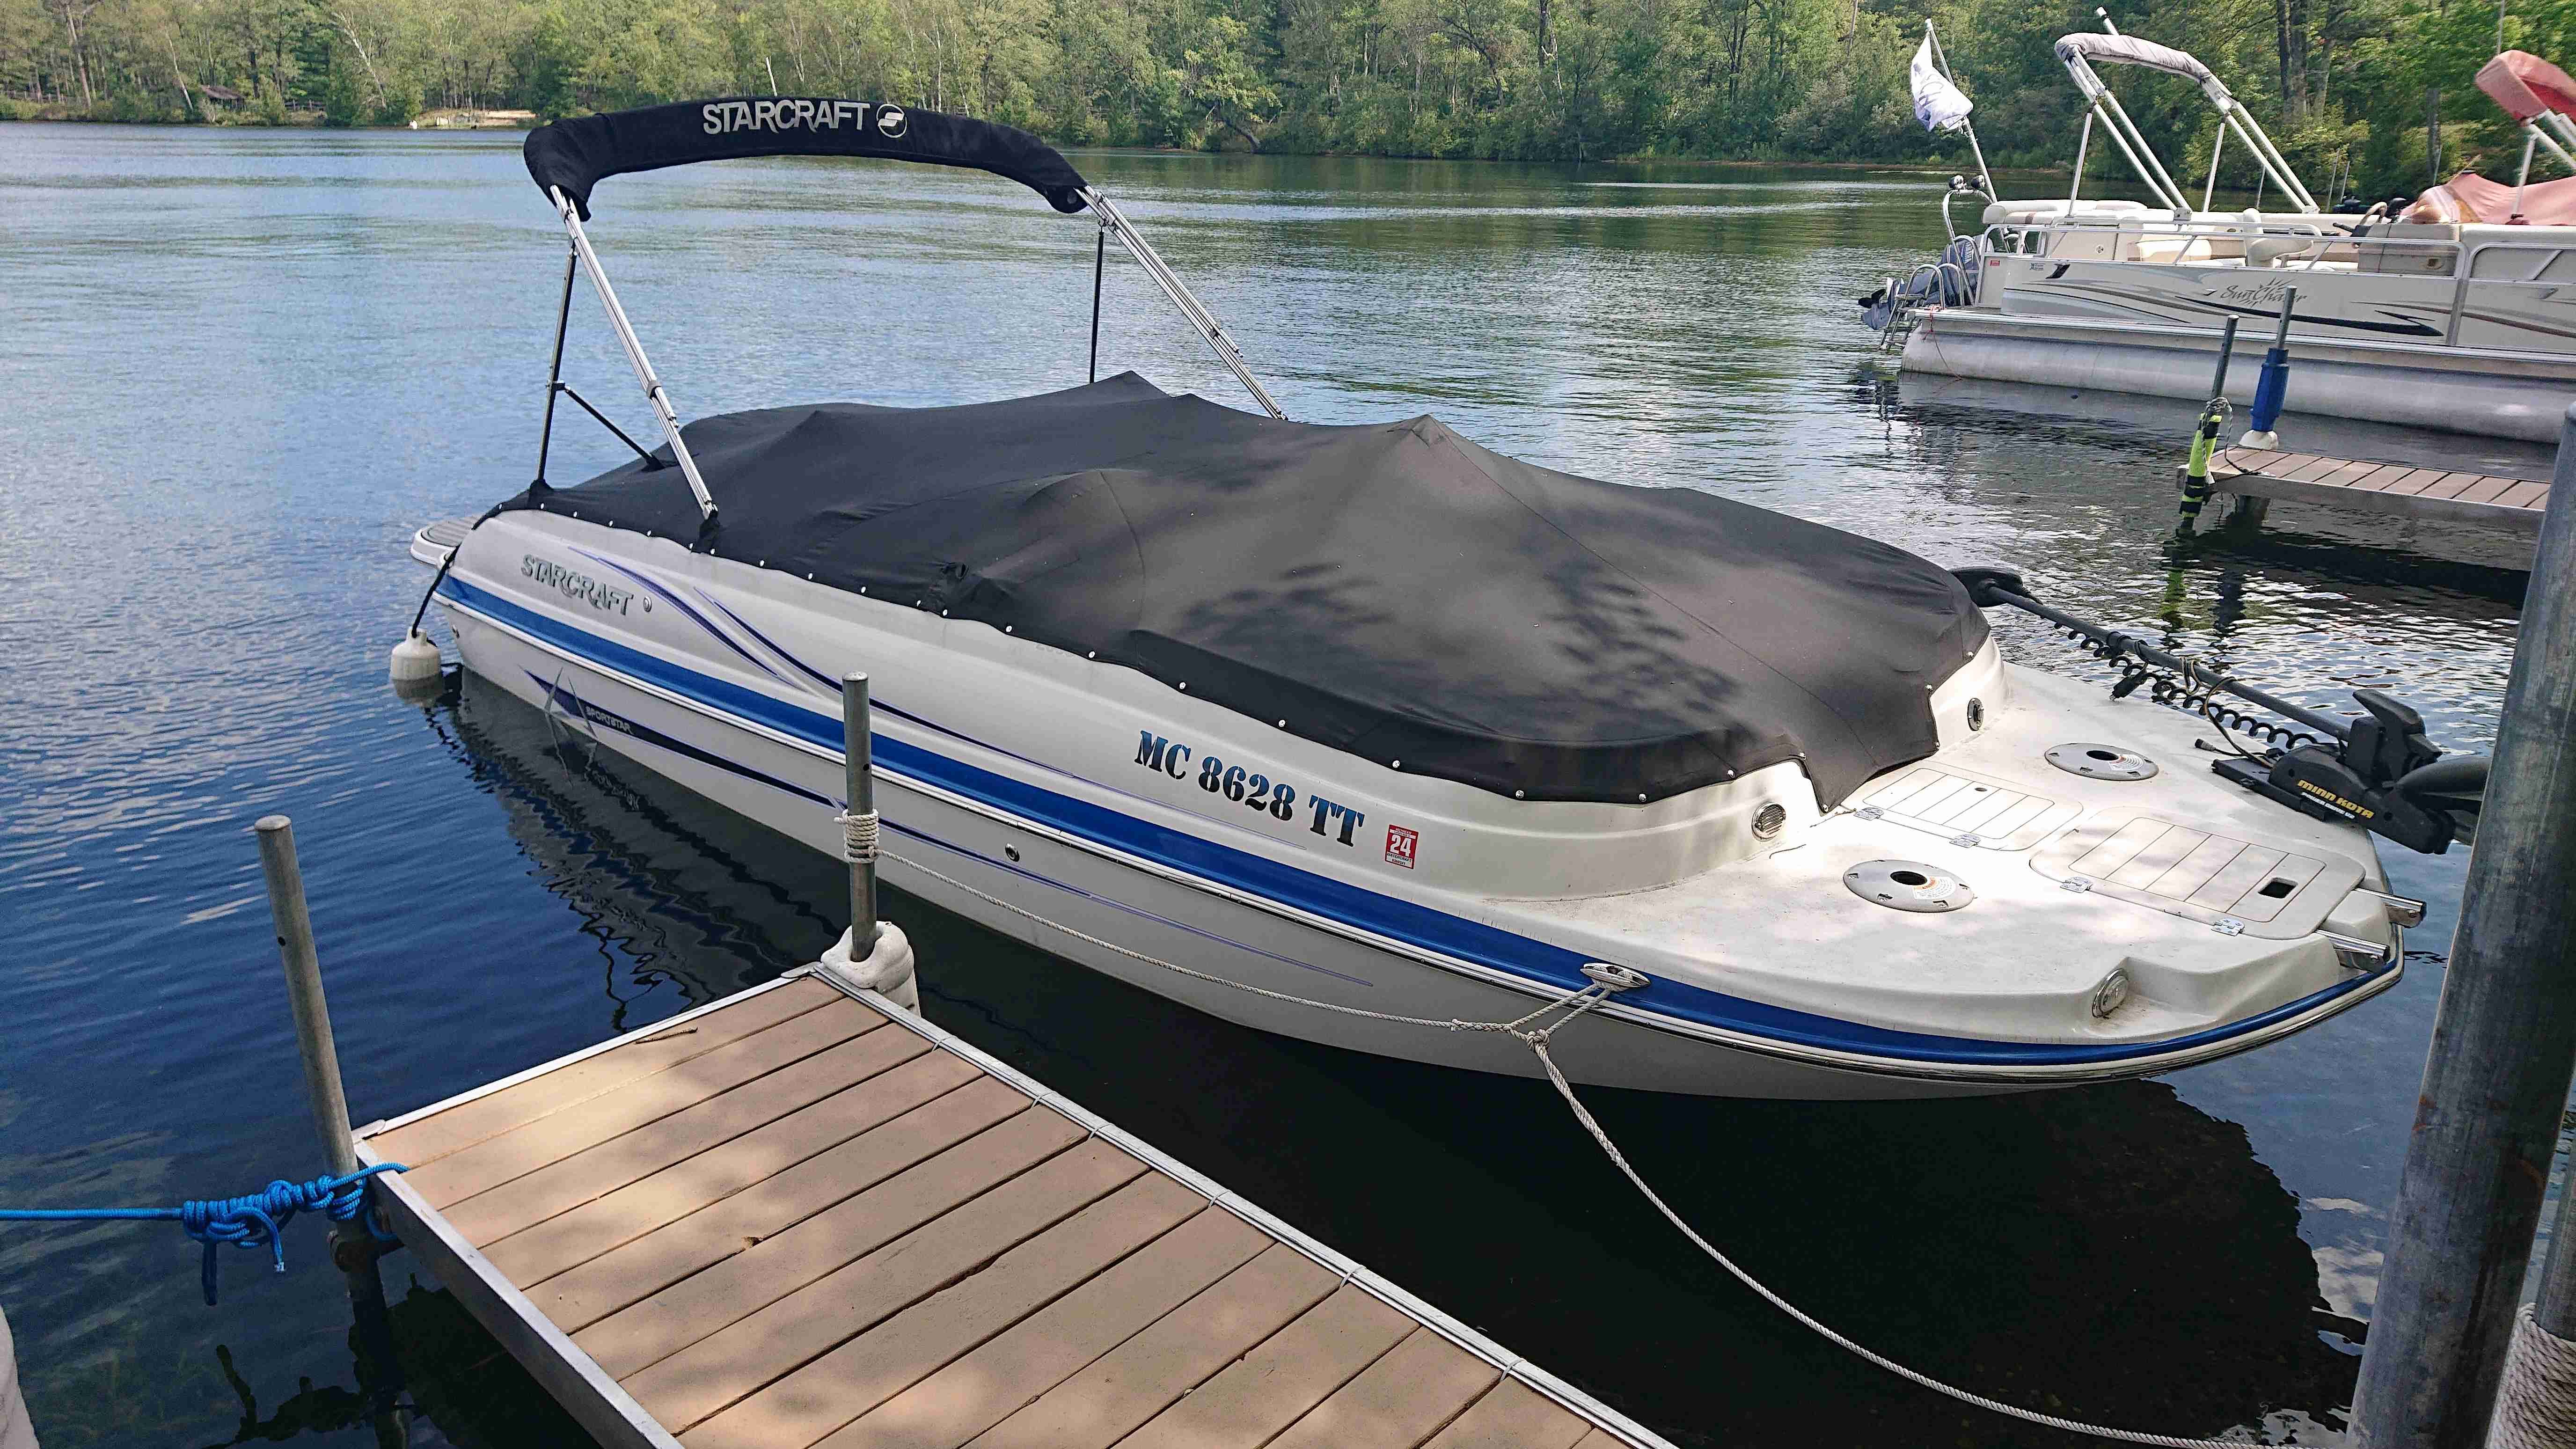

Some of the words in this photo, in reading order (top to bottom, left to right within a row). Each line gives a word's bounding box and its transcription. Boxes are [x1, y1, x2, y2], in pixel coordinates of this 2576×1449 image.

[703, 99, 871, 135] STARCRAFT
[2220, 285, 2308, 304] SunChar
[521, 554, 634, 615] STARCRAFT
[585, 706, 634, 735] SPORTSTAR
[1134, 730, 1191, 780] MC
[1198, 756, 1295, 821] 8628
[1309, 794, 1365, 847] TT
[2298, 779, 2337, 801] MINN
[2336, 797, 2374, 819] KOTA
[1387, 853, 1412, 862] WATERCRAFT
[1390, 834, 1411, 857] 24
